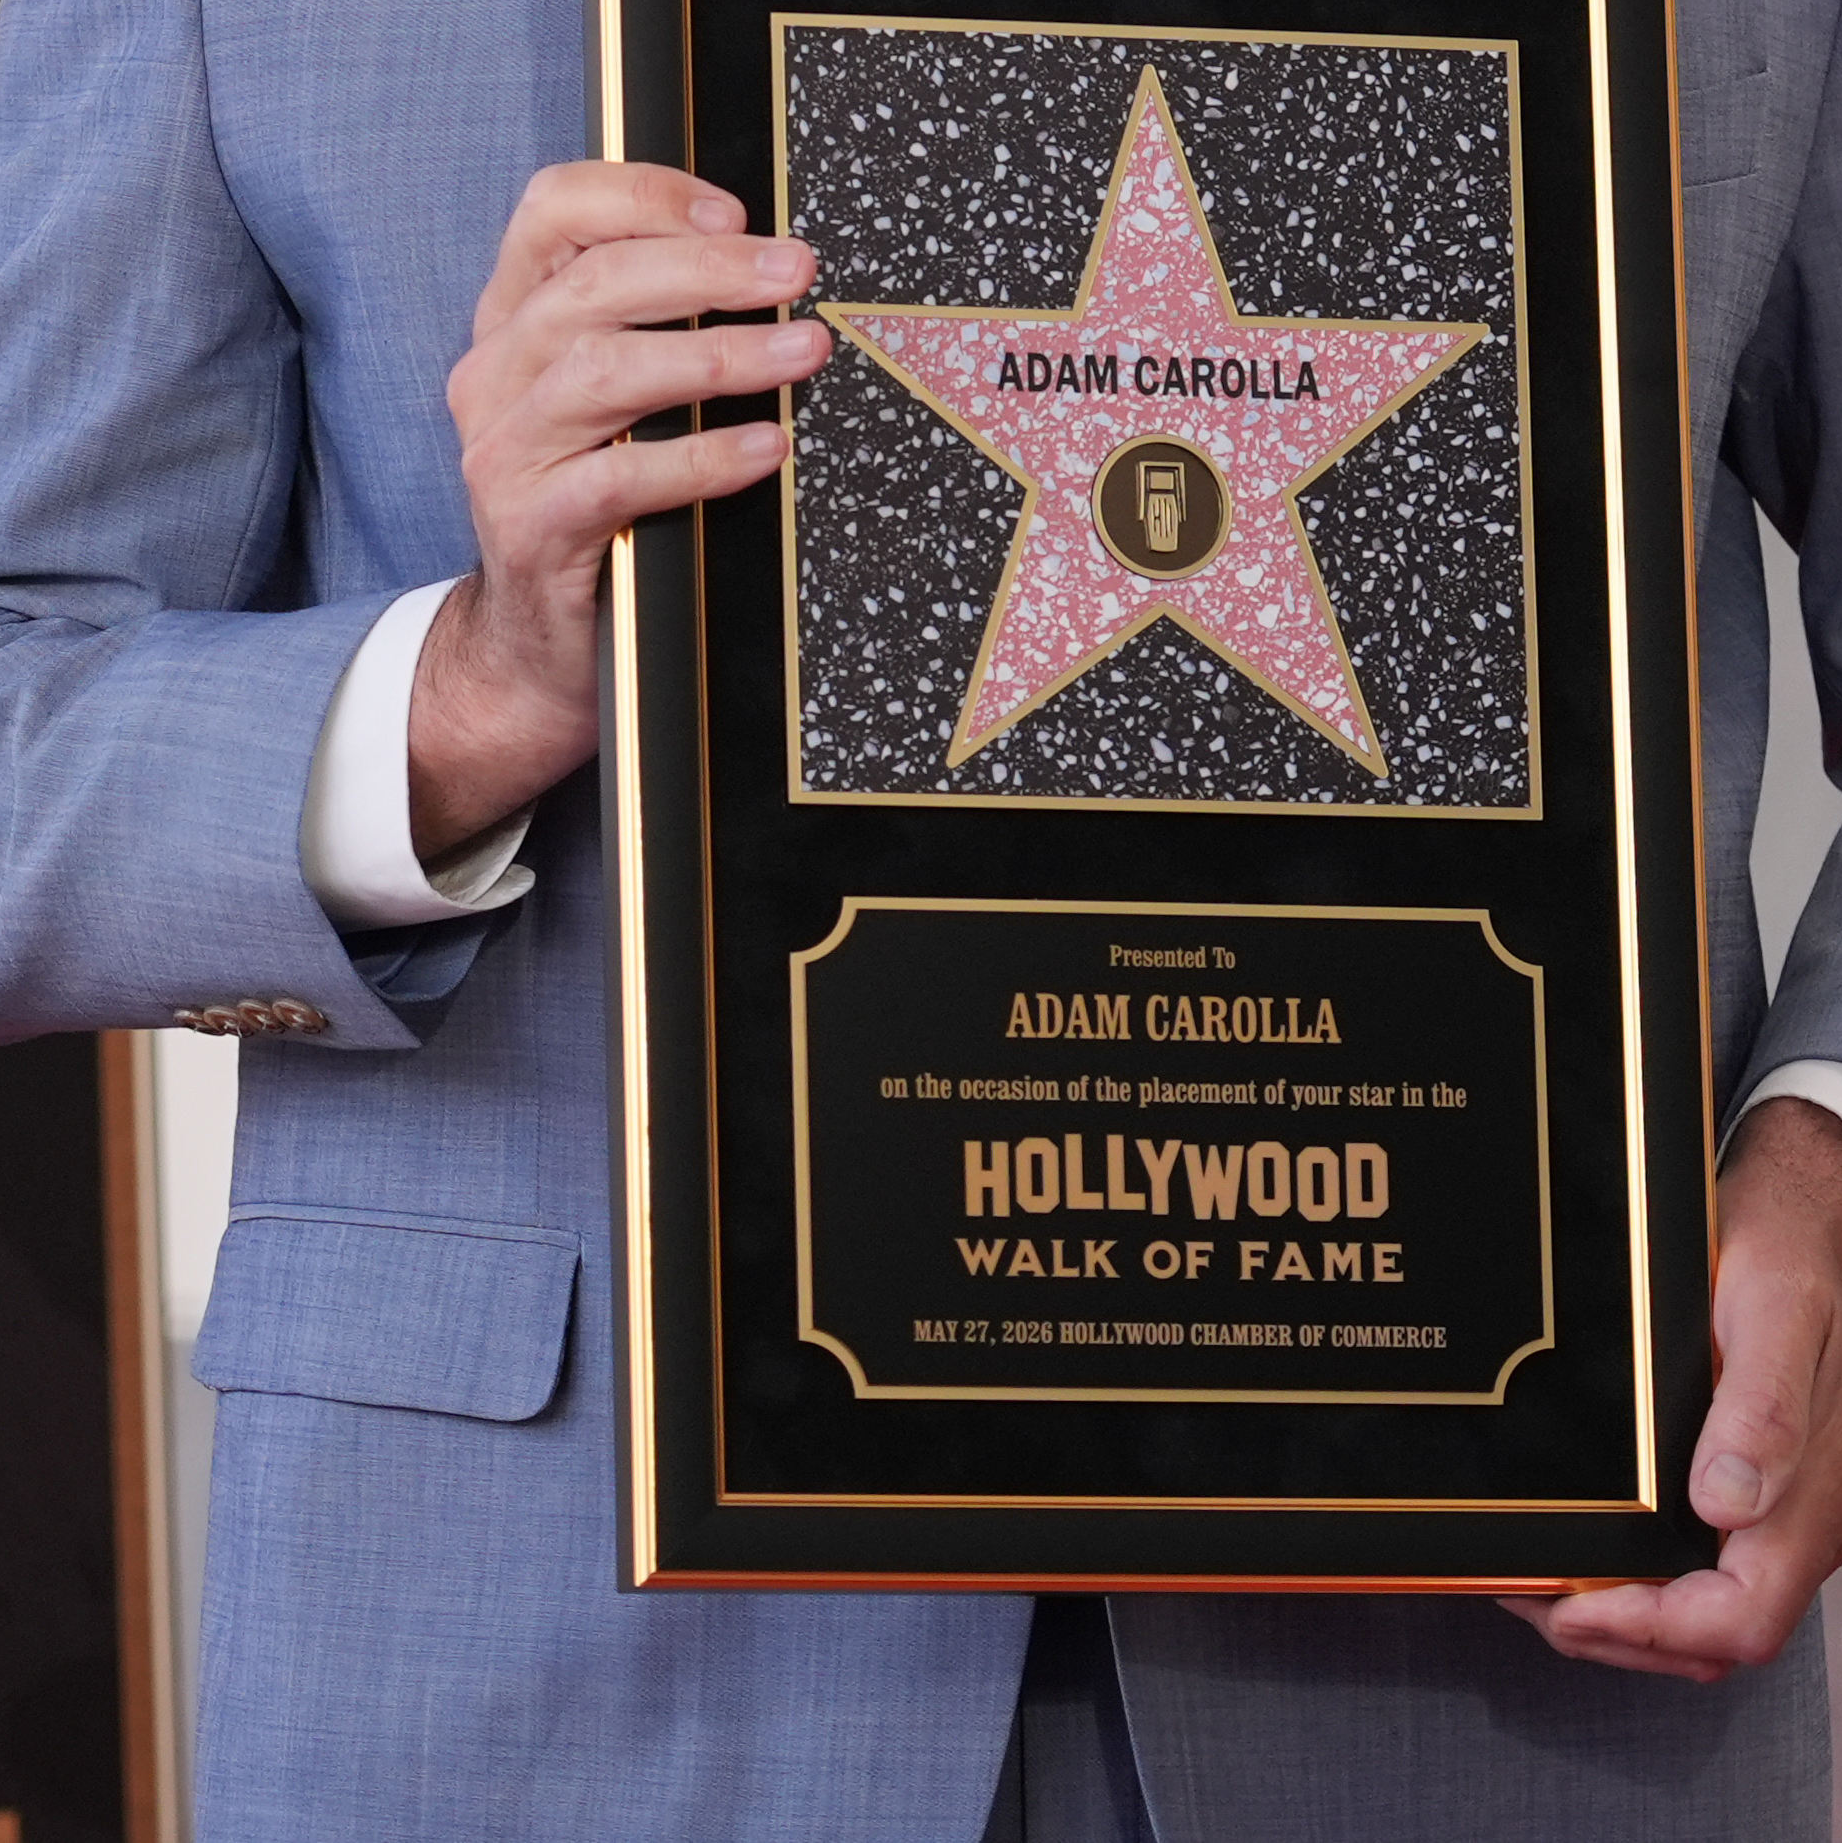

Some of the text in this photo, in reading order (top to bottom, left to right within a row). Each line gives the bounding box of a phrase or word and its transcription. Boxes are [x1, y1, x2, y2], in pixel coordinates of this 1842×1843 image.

[998, 352, 1319, 400] ADAM CAROLLA
[1110, 945, 1235, 968] Presented To
[1006, 993, 1341, 1043] ADAM CAROLLA
[881, 1073, 1466, 1110] on the occasion of the placement of your star in the
[965, 1134, 1389, 1221] HOLLYWOOD
[956, 1238, 1403, 1282] WALK OF FAME
[915, 1320, 1446, 1348] MAY 27, 2026 HOLLYWOOD CHAMBER OF COMMERCE
